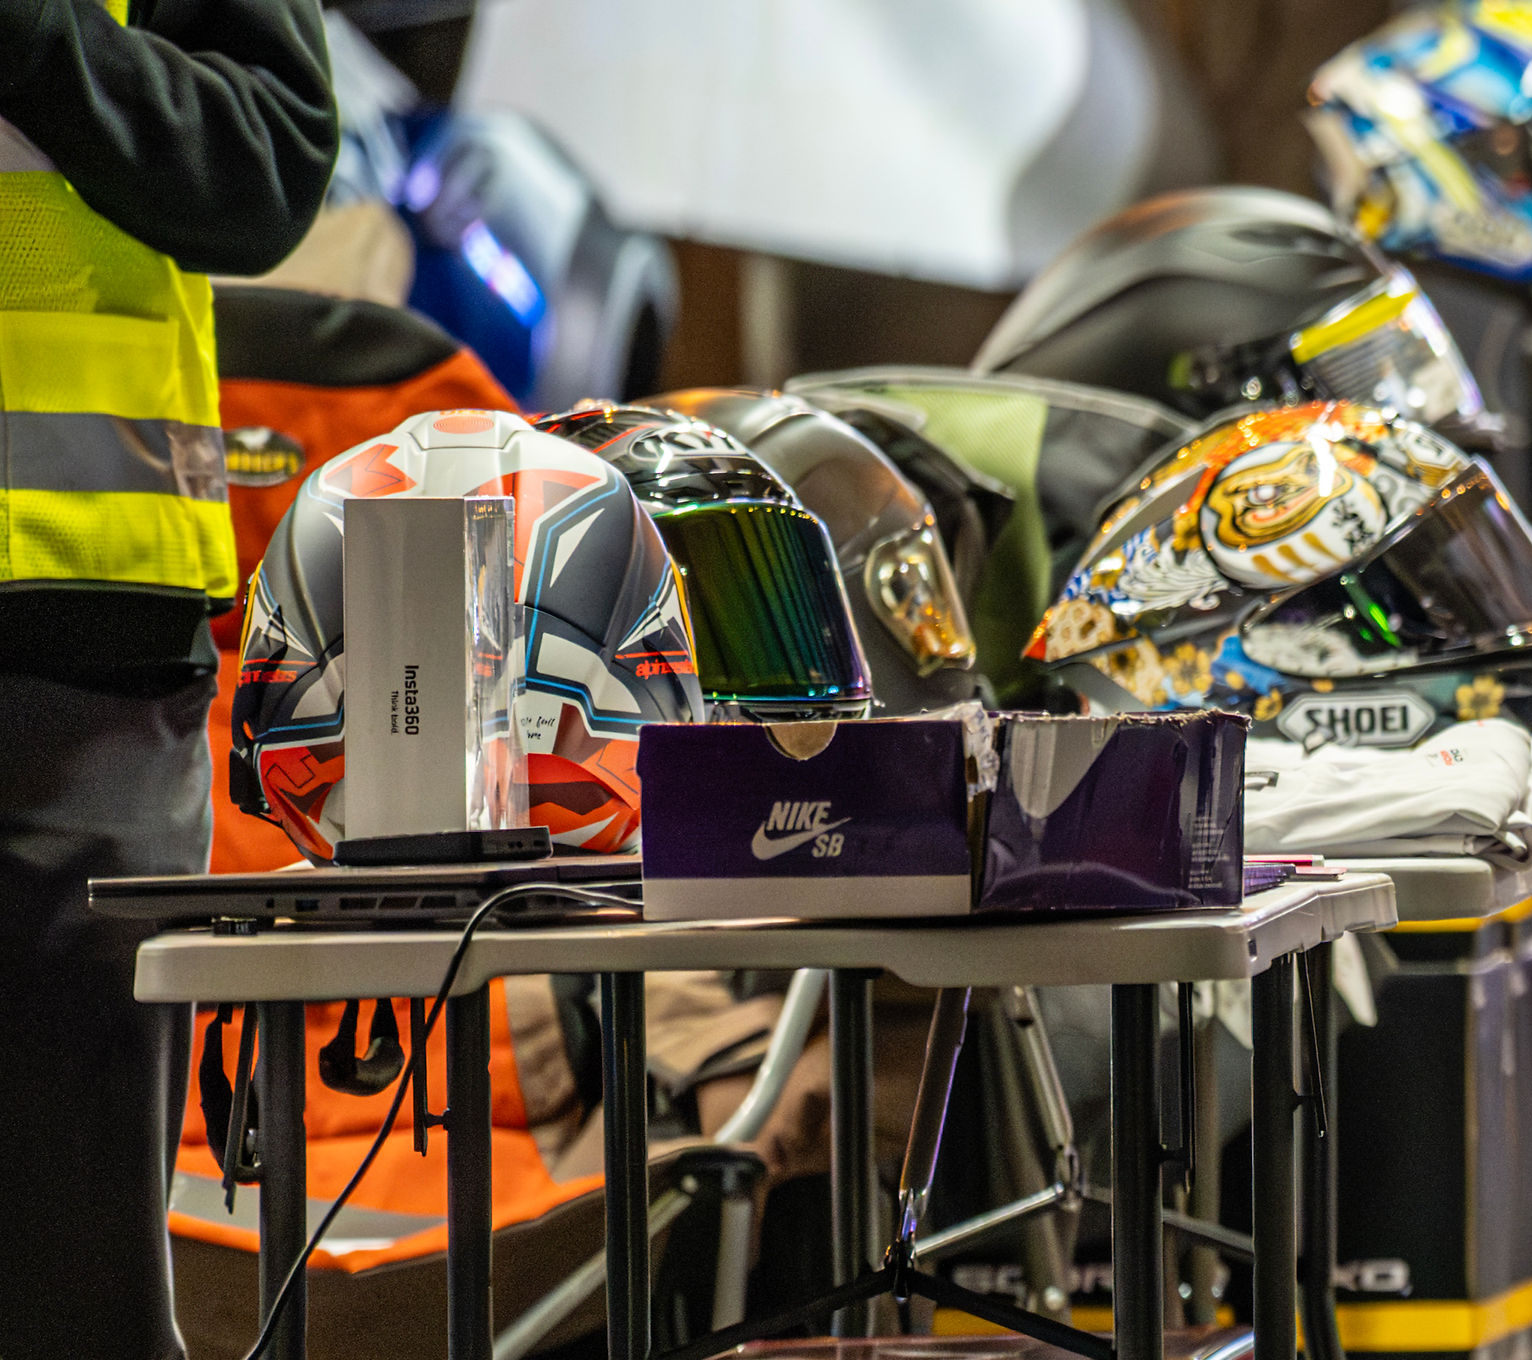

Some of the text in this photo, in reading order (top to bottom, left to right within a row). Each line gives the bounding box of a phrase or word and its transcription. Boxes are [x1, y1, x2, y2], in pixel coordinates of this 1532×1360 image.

[404, 665, 420, 736] Insta360
[1305, 705, 1409, 735] SHOEI
[766, 801, 831, 832] NIKE
[811, 833, 845, 858] SB
